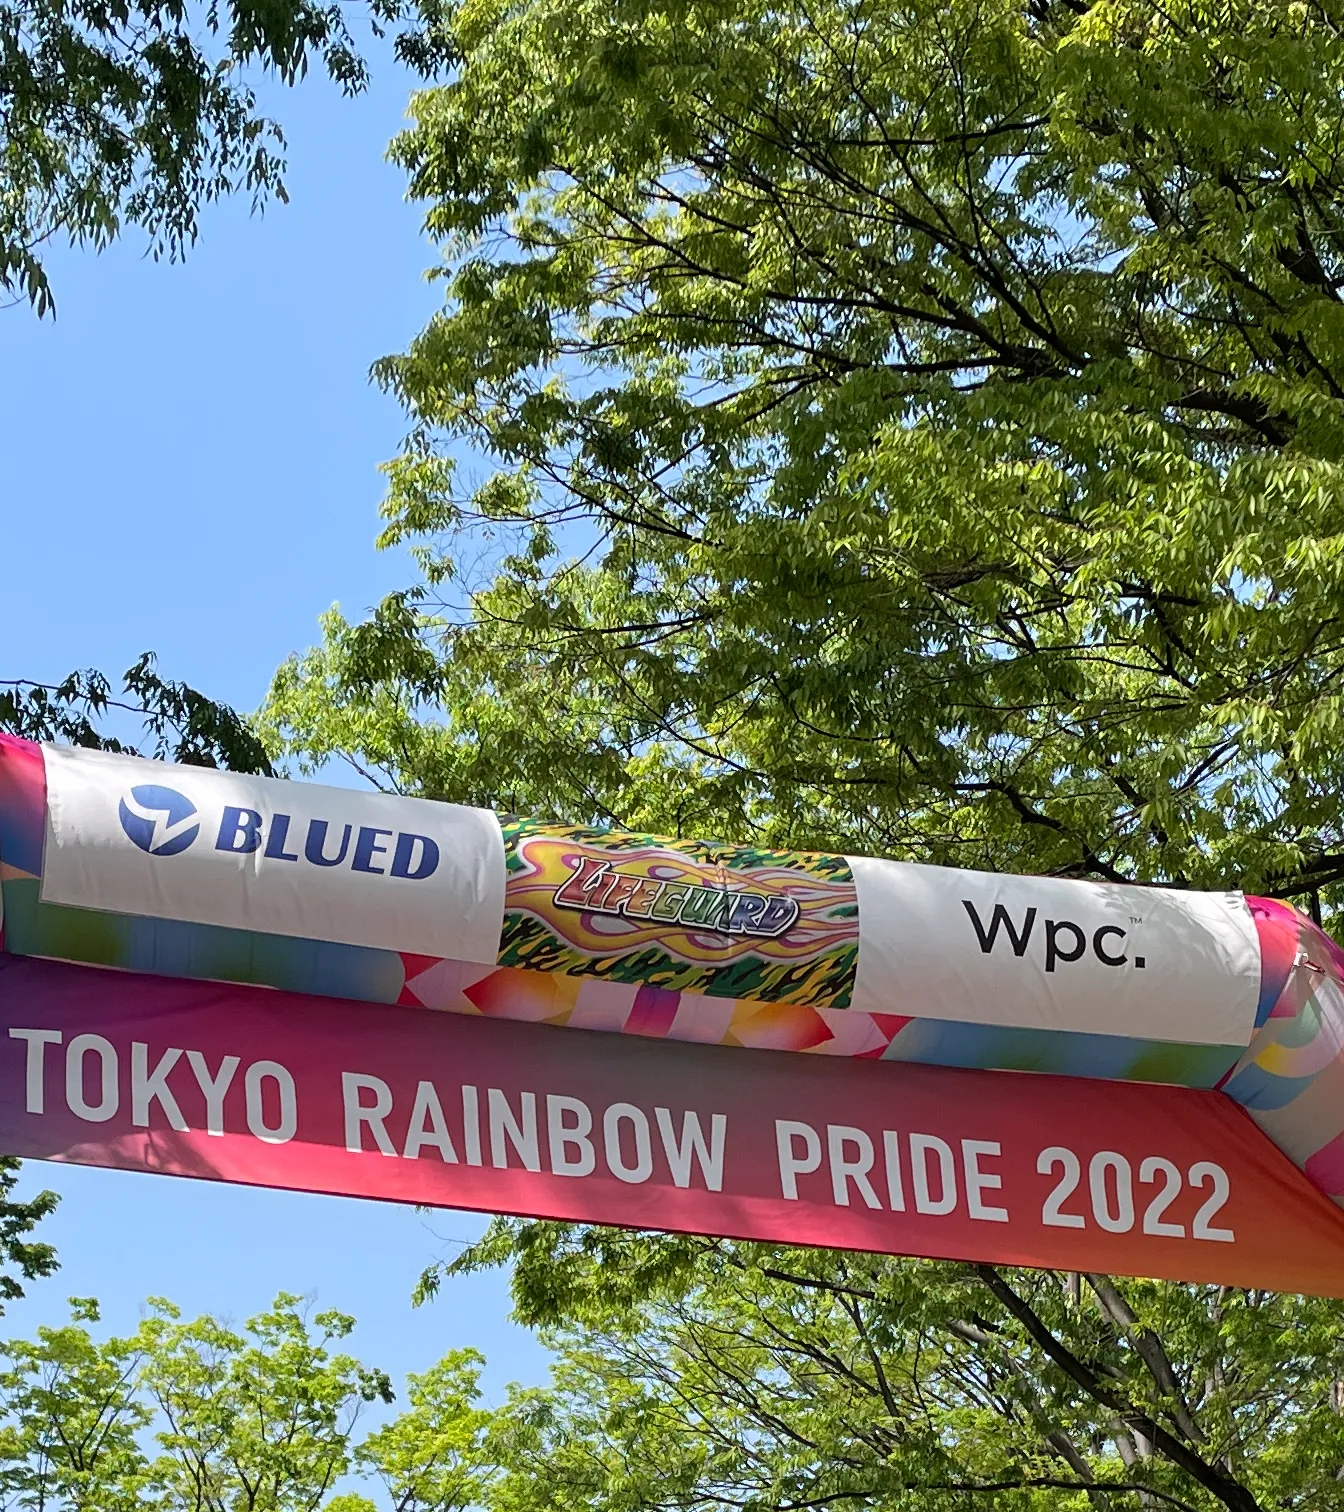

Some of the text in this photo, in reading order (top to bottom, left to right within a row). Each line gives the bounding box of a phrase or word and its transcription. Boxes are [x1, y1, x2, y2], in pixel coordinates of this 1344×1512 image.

[214, 805, 440, 880] BLUED
[552, 856, 801, 937] LIFEGUARD
[8, 1027, 1235, 1243] TOKYO RAINBOW PRIDE 2022
